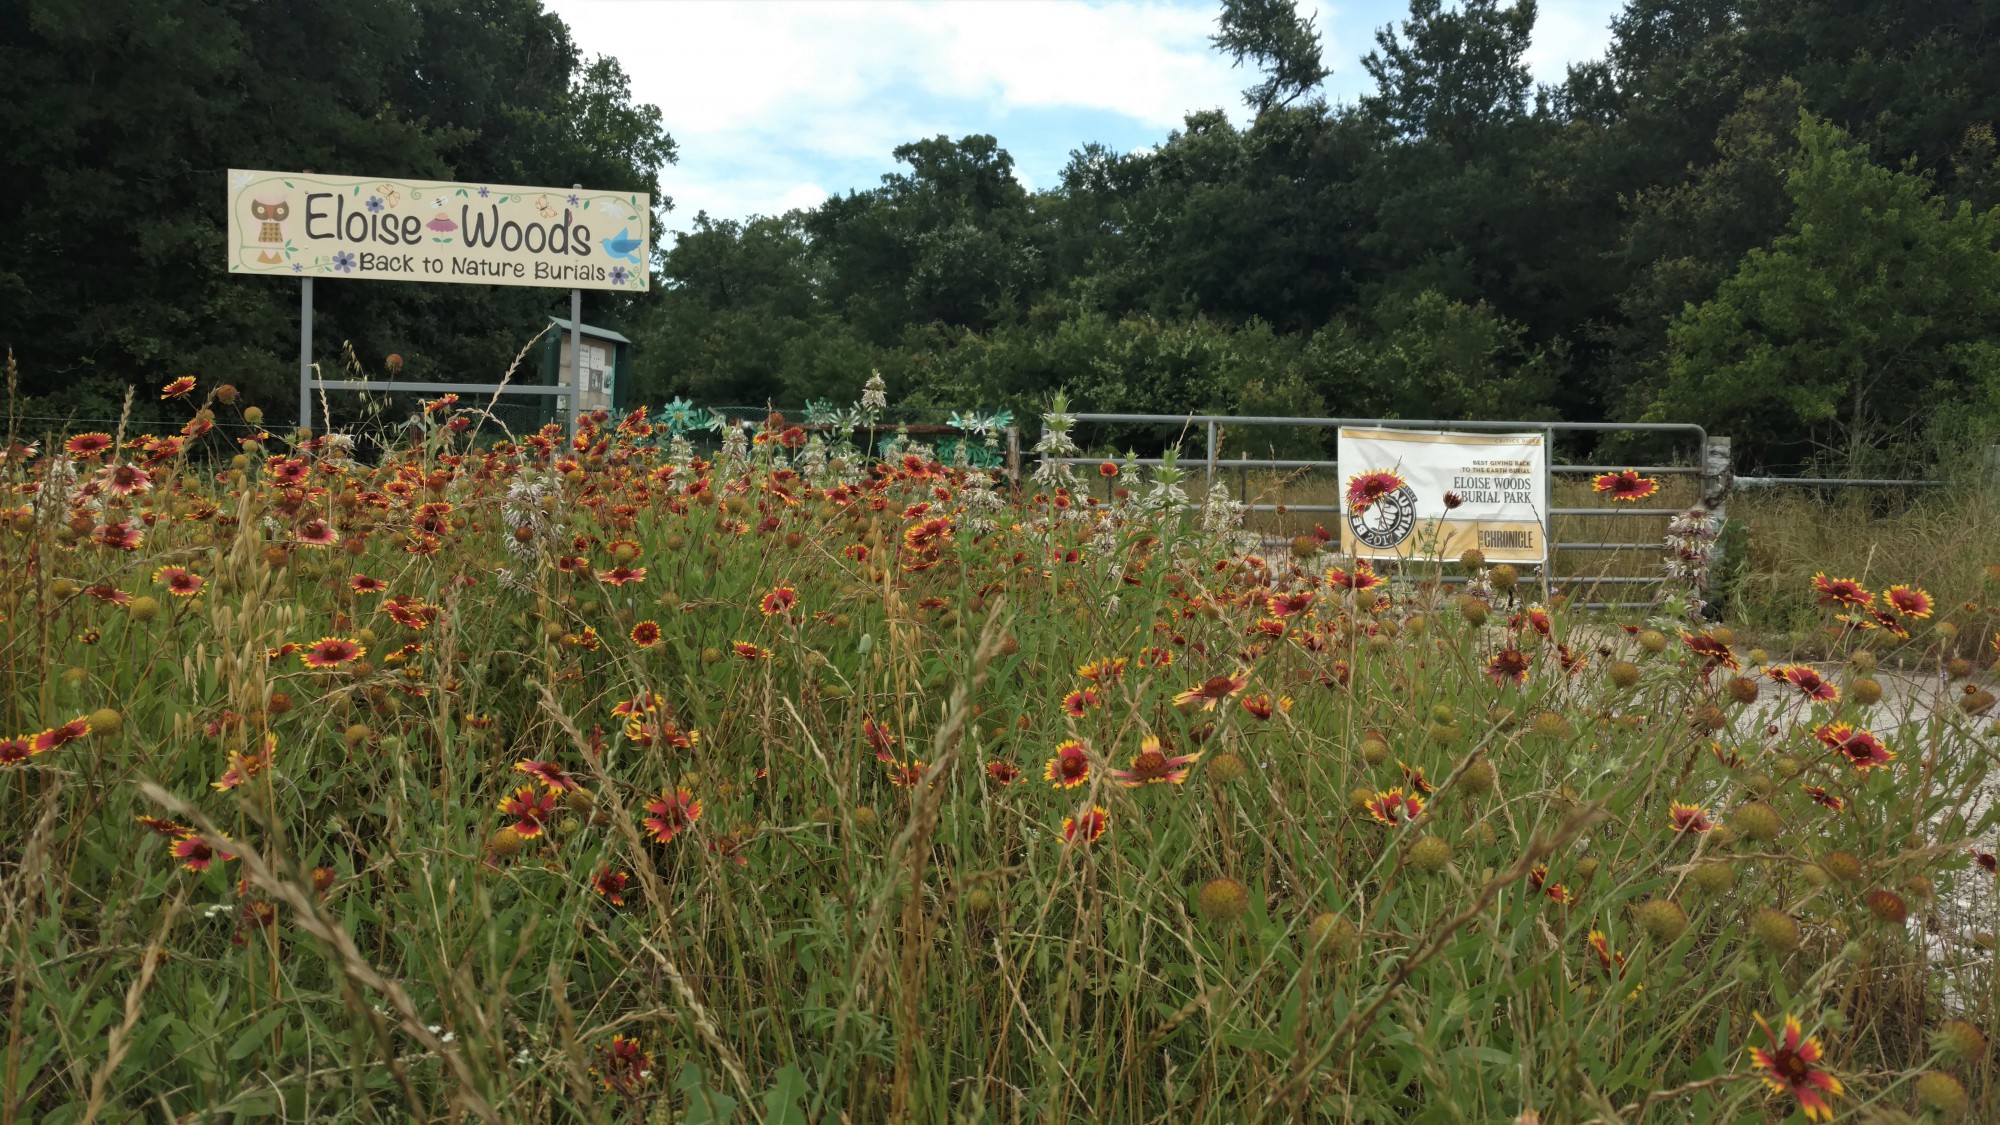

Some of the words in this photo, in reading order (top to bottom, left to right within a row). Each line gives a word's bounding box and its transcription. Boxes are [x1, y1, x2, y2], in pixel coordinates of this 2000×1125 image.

[305, 192, 422, 245] Eloise
[461, 203, 592, 257] Woods
[359, 252, 414, 273] Back
[421, 257, 444, 274] to
[451, 256, 526, 278] Nature
[534, 260, 606, 281] Burials
[1453, 476, 1491, 490] ELOISE
[1494, 477, 1532, 491] WOODS
[1460, 490, 1501, 503] BURIAL
[1503, 491, 1532, 504] PARK
[1389, 489, 1413, 539] AUSTIN
[1364, 532, 1394, 546] 2017
[1484, 530, 1534, 549] CHRONICLE
